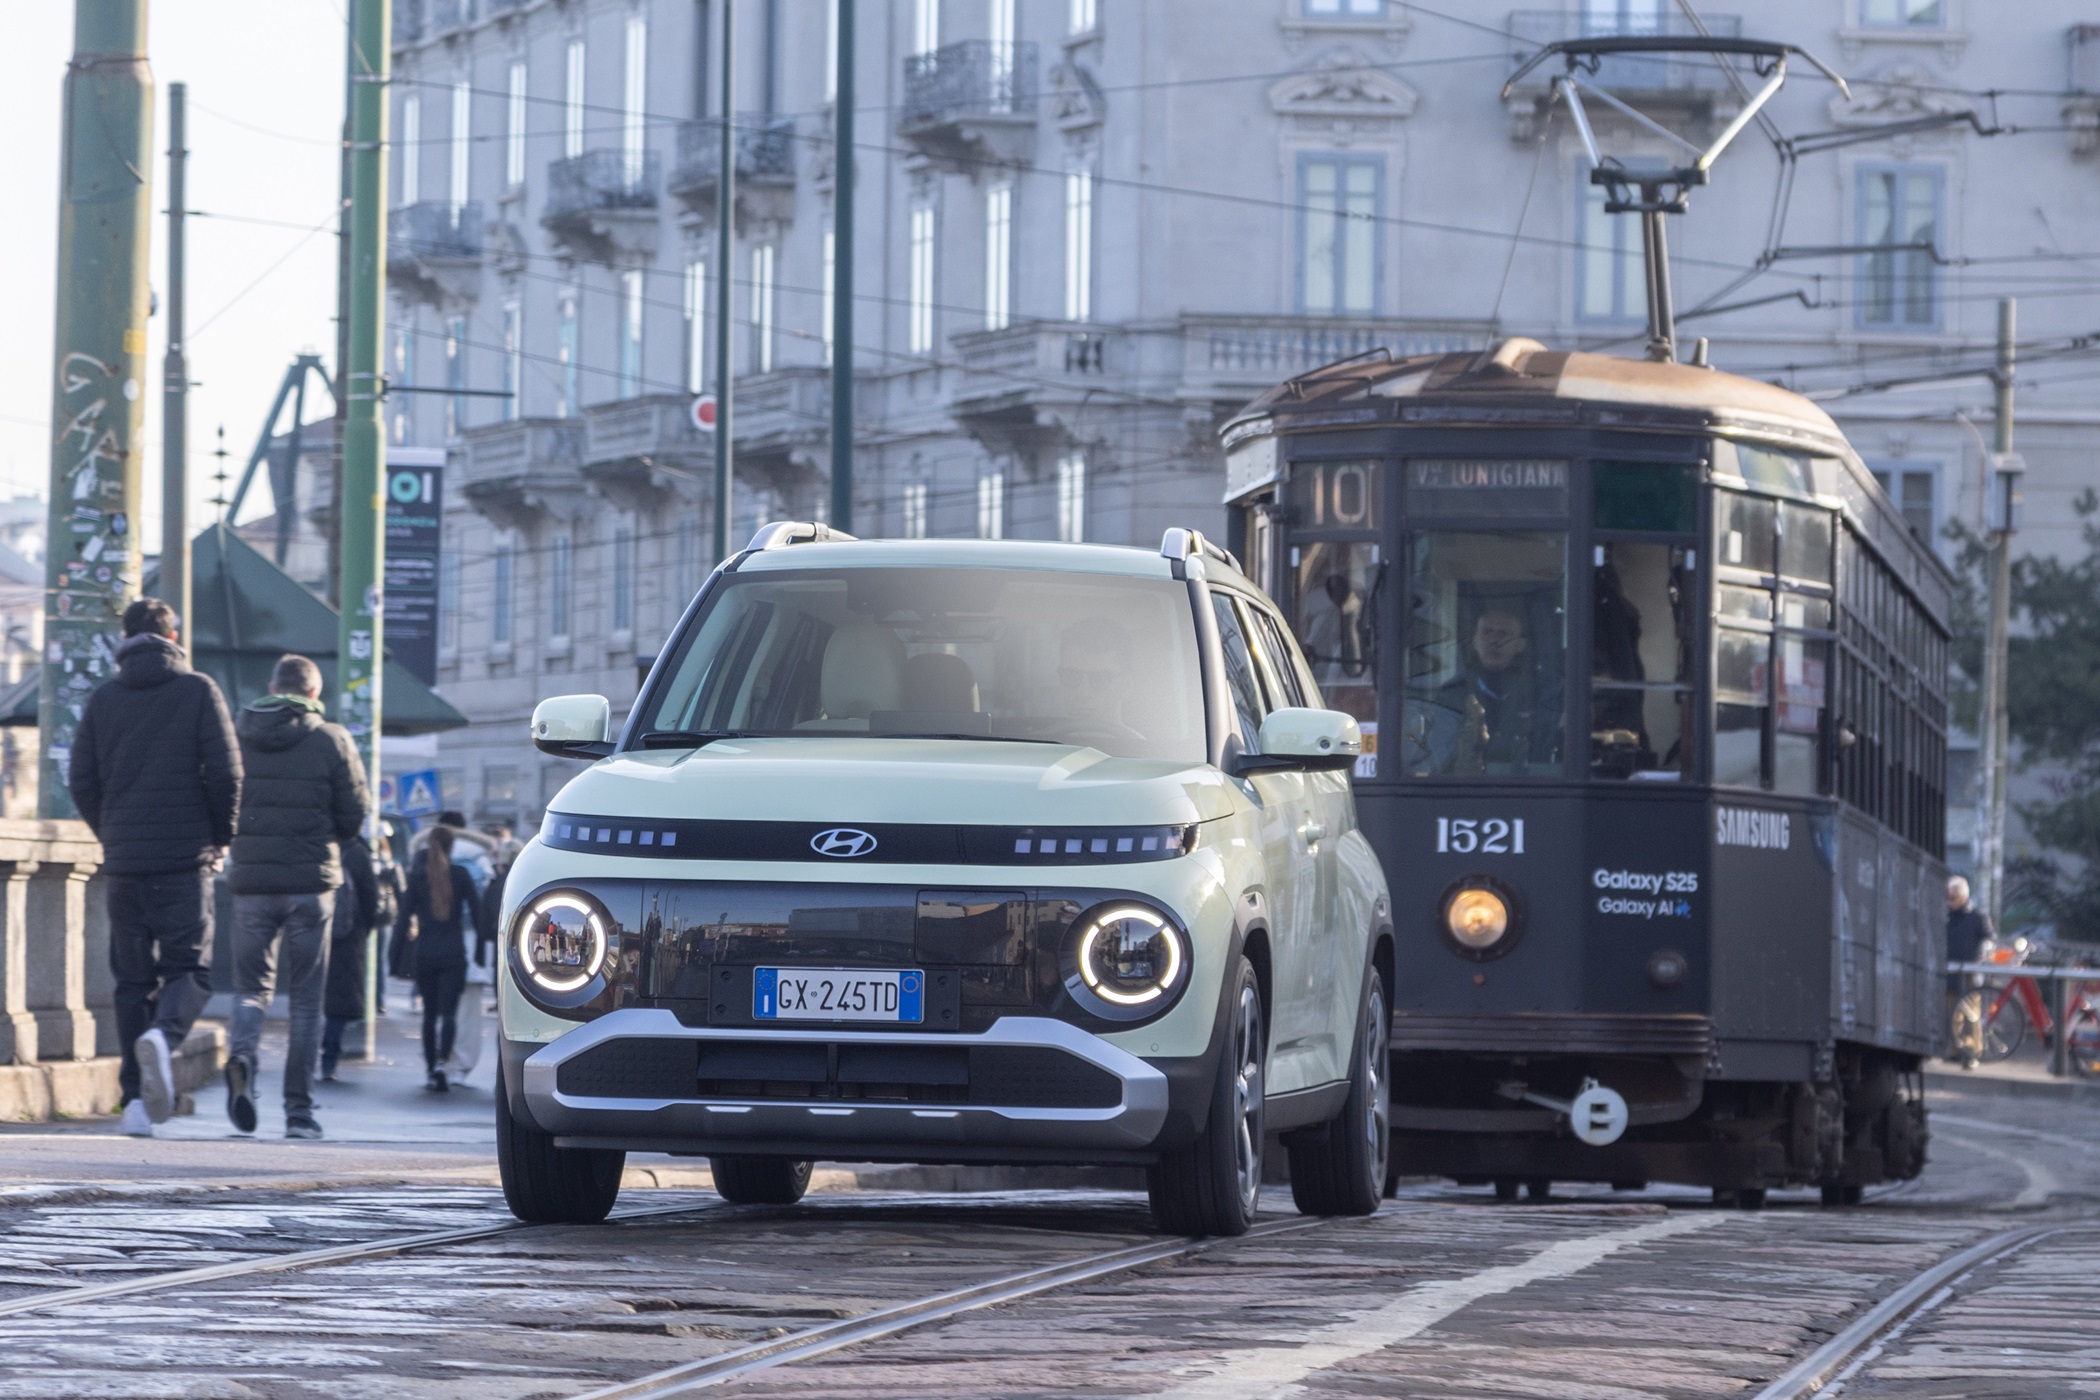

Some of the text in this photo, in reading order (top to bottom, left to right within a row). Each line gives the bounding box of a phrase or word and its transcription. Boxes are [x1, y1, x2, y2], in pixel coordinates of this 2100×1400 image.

[1314, 464, 1366, 524] 10
[1437, 817, 1525, 854] 1521
[1717, 807, 1790, 850] SAMSUNG
[1594, 868, 1698, 895] Galaxy S25
[1598, 897, 1674, 919] Galaxy AI
